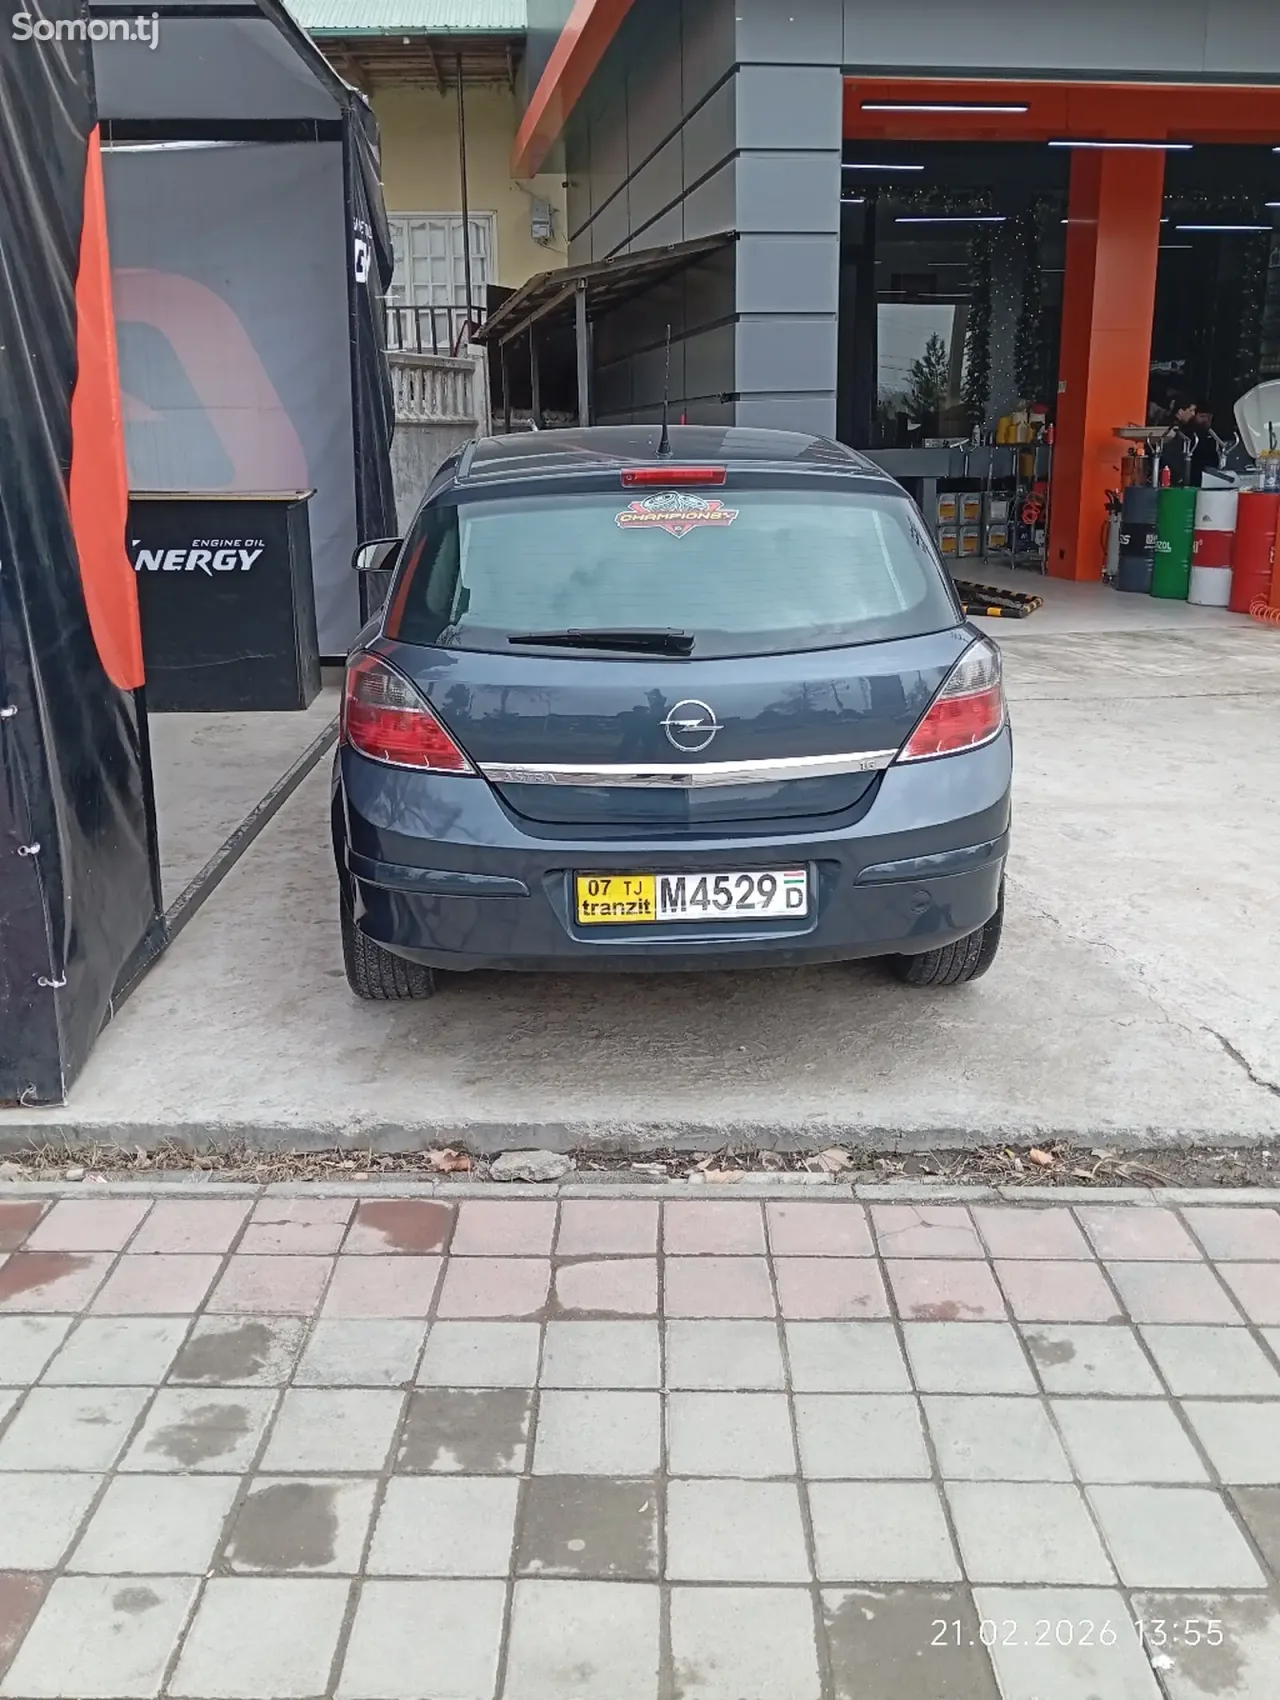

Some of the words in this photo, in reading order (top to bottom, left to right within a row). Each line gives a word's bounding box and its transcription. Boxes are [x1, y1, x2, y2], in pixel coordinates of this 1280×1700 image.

[191, 539, 242, 547] ENGINE
[244, 539, 266, 547] OIL
[134, 549, 264, 577] NERGY
[588, 879, 612, 897] 07
[623, 881, 643, 896] TJ
[660, 873, 777, 913] M4529
[785, 887, 804, 909] D
[581, 898, 652, 916] tranzit
